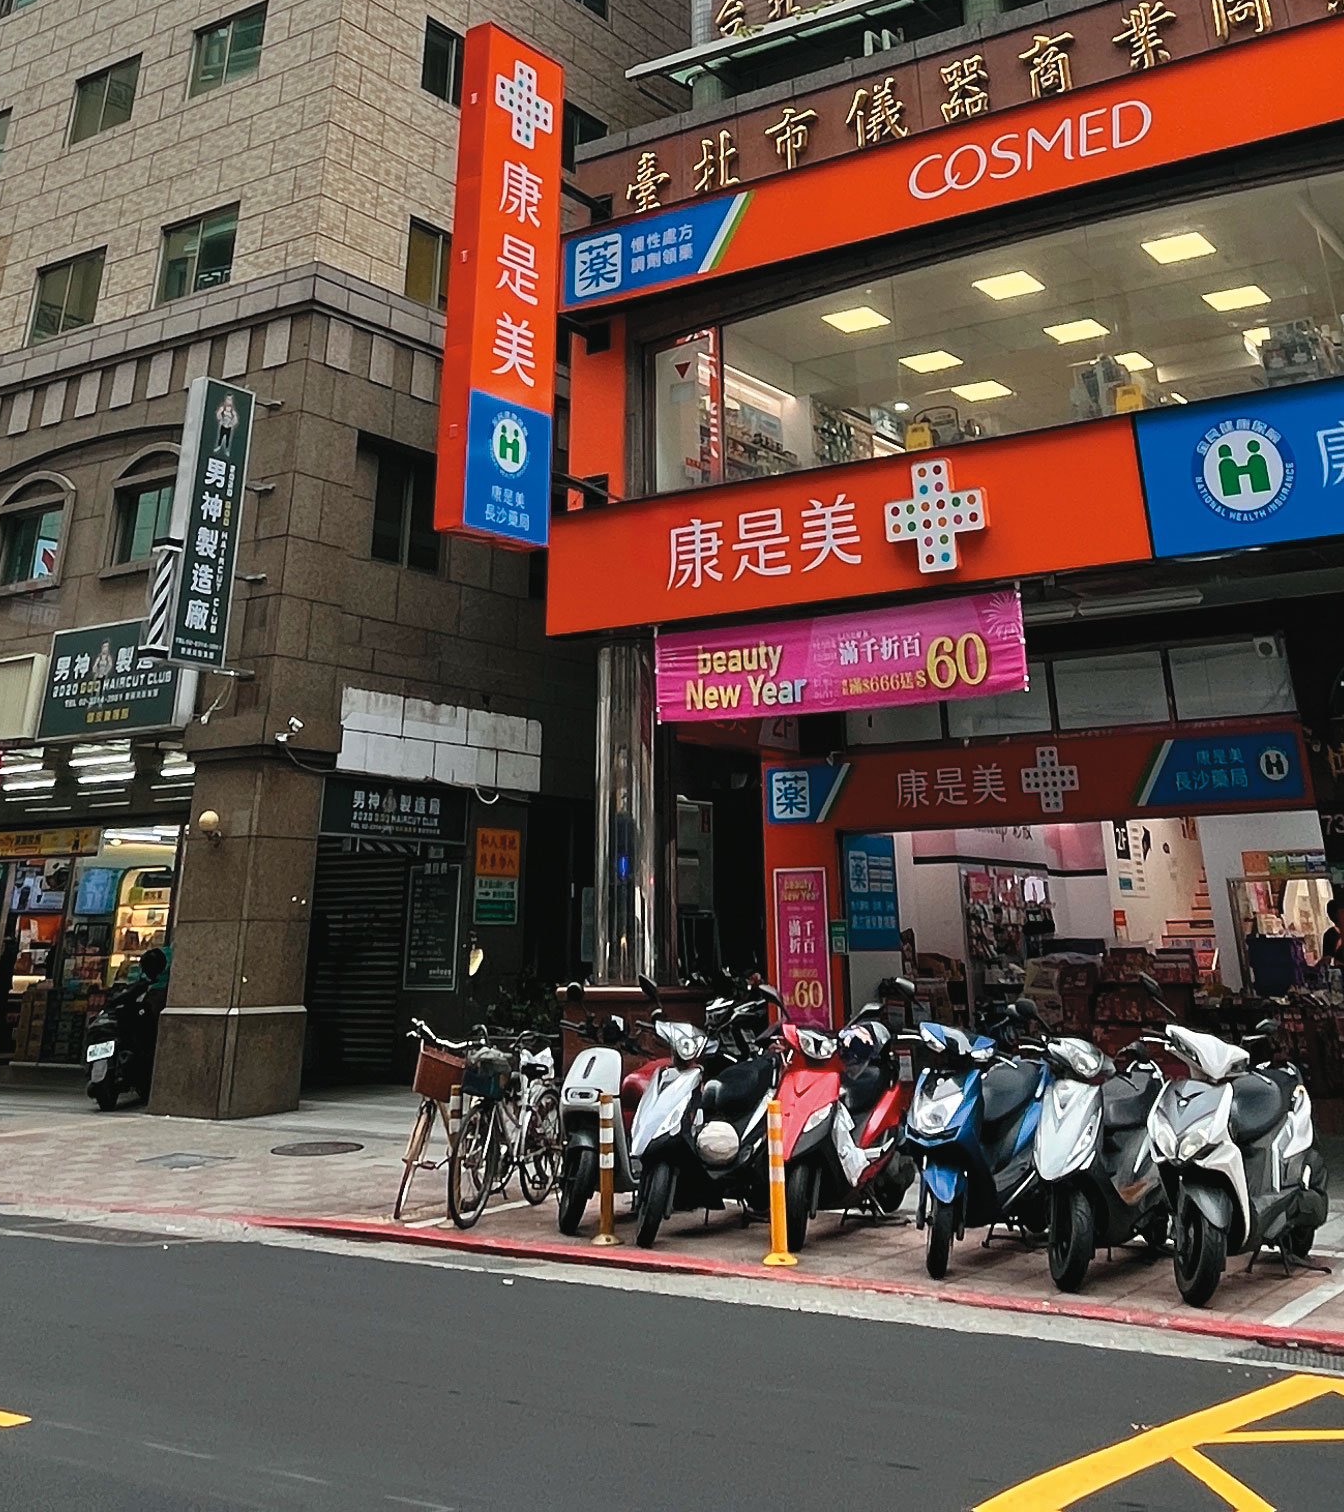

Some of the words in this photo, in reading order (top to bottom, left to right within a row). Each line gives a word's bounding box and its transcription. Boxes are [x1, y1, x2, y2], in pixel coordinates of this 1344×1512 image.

[907, 100, 1152, 200] COSMED
[491, 160, 543, 387] 康是美
[184, 458, 226, 631] 男神製造廠
[667, 493, 862, 592] 康是美
[698, 642, 782, 675] beauty
[838, 631, 920, 666] 滿千折百
[686, 680, 742, 710] New
[746, 675, 807, 706] Year
[897, 764, 1007, 809] 康是美
[794, 980, 824, 1008] 60
